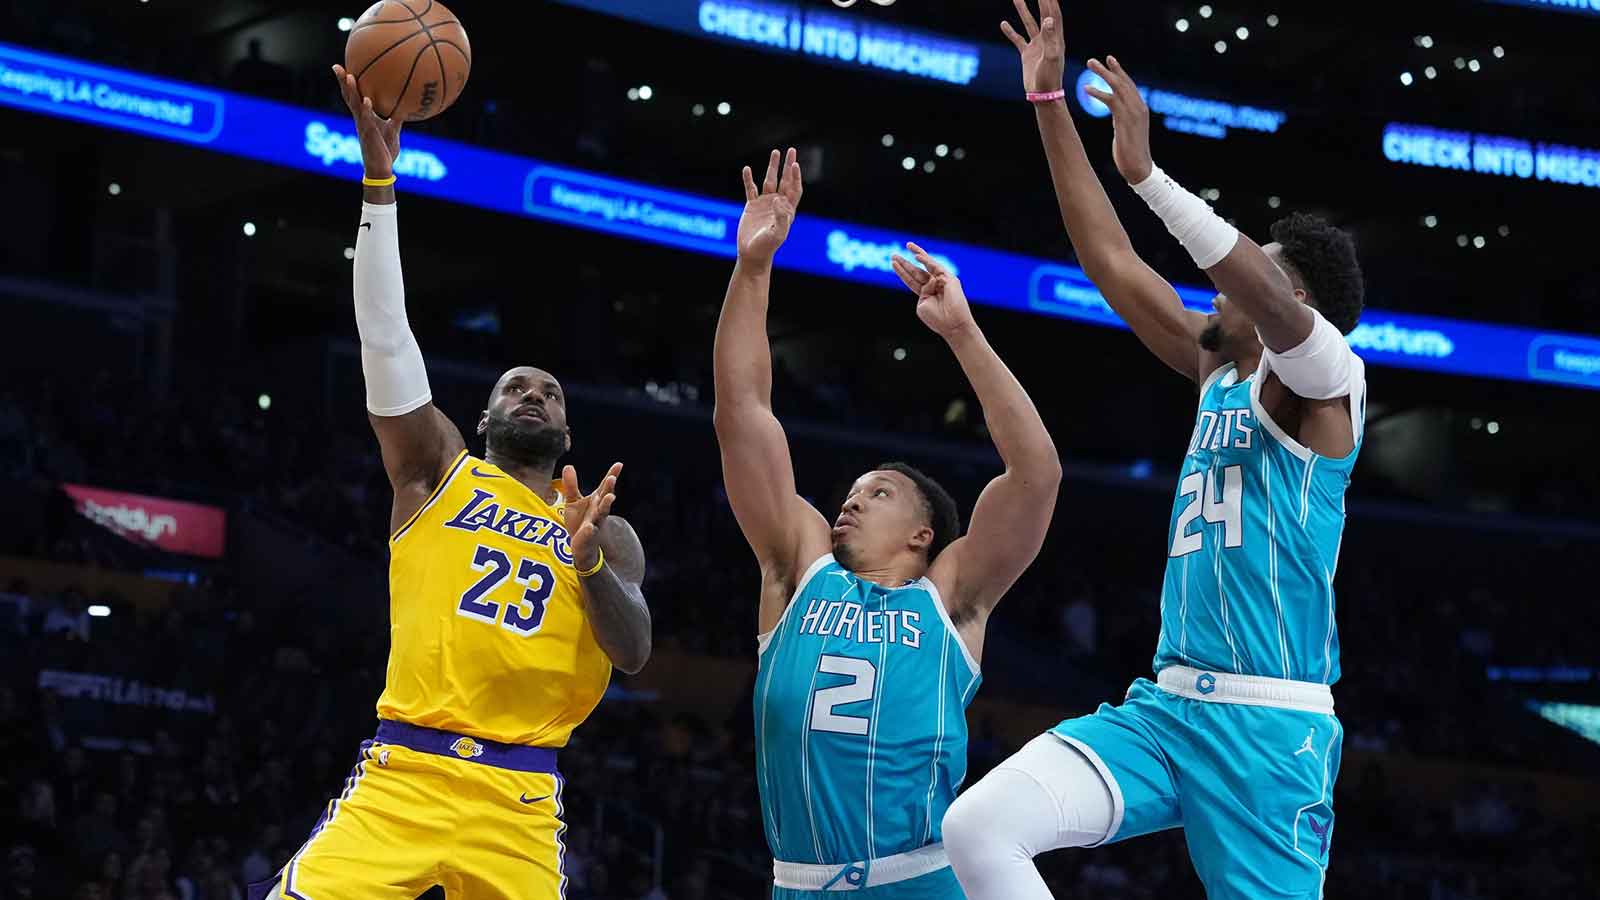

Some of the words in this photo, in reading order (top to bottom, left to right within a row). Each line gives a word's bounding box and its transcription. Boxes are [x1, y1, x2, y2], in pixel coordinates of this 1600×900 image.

[699, 3, 788, 48] CHECK
[859, 36, 979, 85] MISCHIEF
[66, 79, 93, 104] LA
[94, 83, 194, 126] Connected
[1383, 130, 1471, 171] CHECK
[1472, 143, 1534, 179] INTO
[552, 183, 616, 222] Keeping
[616, 199, 640, 220] LA
[640, 201, 727, 240] Connected
[444, 488, 575, 567] LAKERS
[1168, 464, 1244, 558] 24
[456, 544, 556, 637] 23
[809, 653, 877, 736] 2
